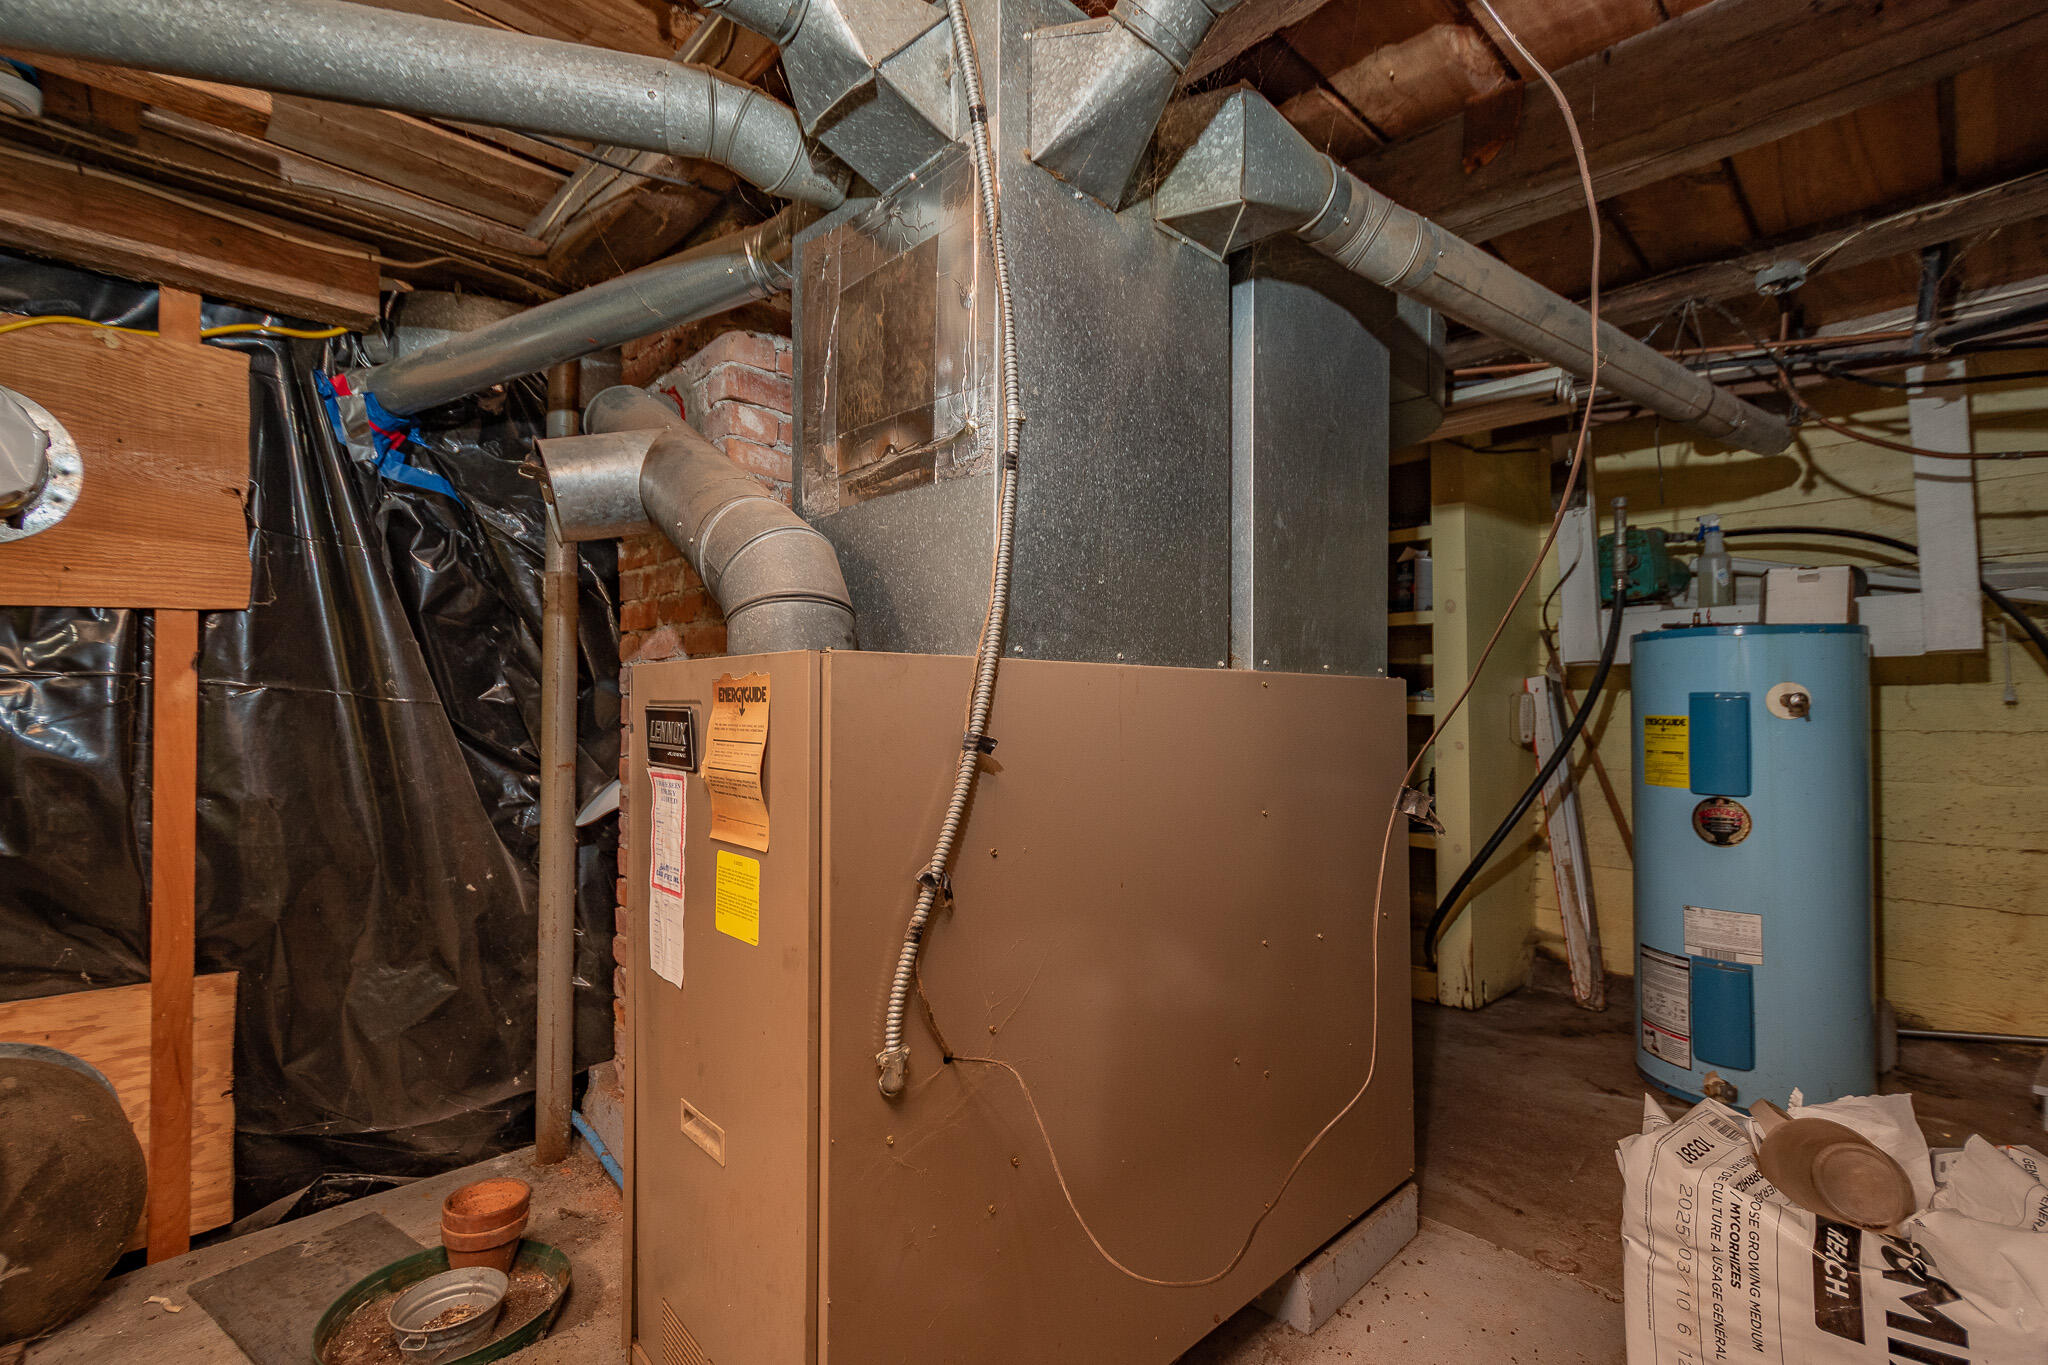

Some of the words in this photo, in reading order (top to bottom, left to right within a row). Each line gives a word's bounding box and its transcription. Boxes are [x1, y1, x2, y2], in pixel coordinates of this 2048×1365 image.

[718, 686, 767, 703] ENERGYGUIDE
[650, 720, 688, 745] LENNOX
[1676, 1136, 1715, 1164] 10381
[1710, 1182, 1724, 1242] CULTURE
[1675, 1183, 1693, 1311] 2025/03/10
[1729, 1202, 1742, 1289] MYCORHIZES
[1748, 1231, 1761, 1298] GROWING
[1824, 1227, 1850, 1300] REACH
[1711, 1256, 1723, 1301] USAGE
[1712, 1302, 1728, 1360] GÉNÉRAL
[1749, 1300, 1764, 1353] MEDIUM
